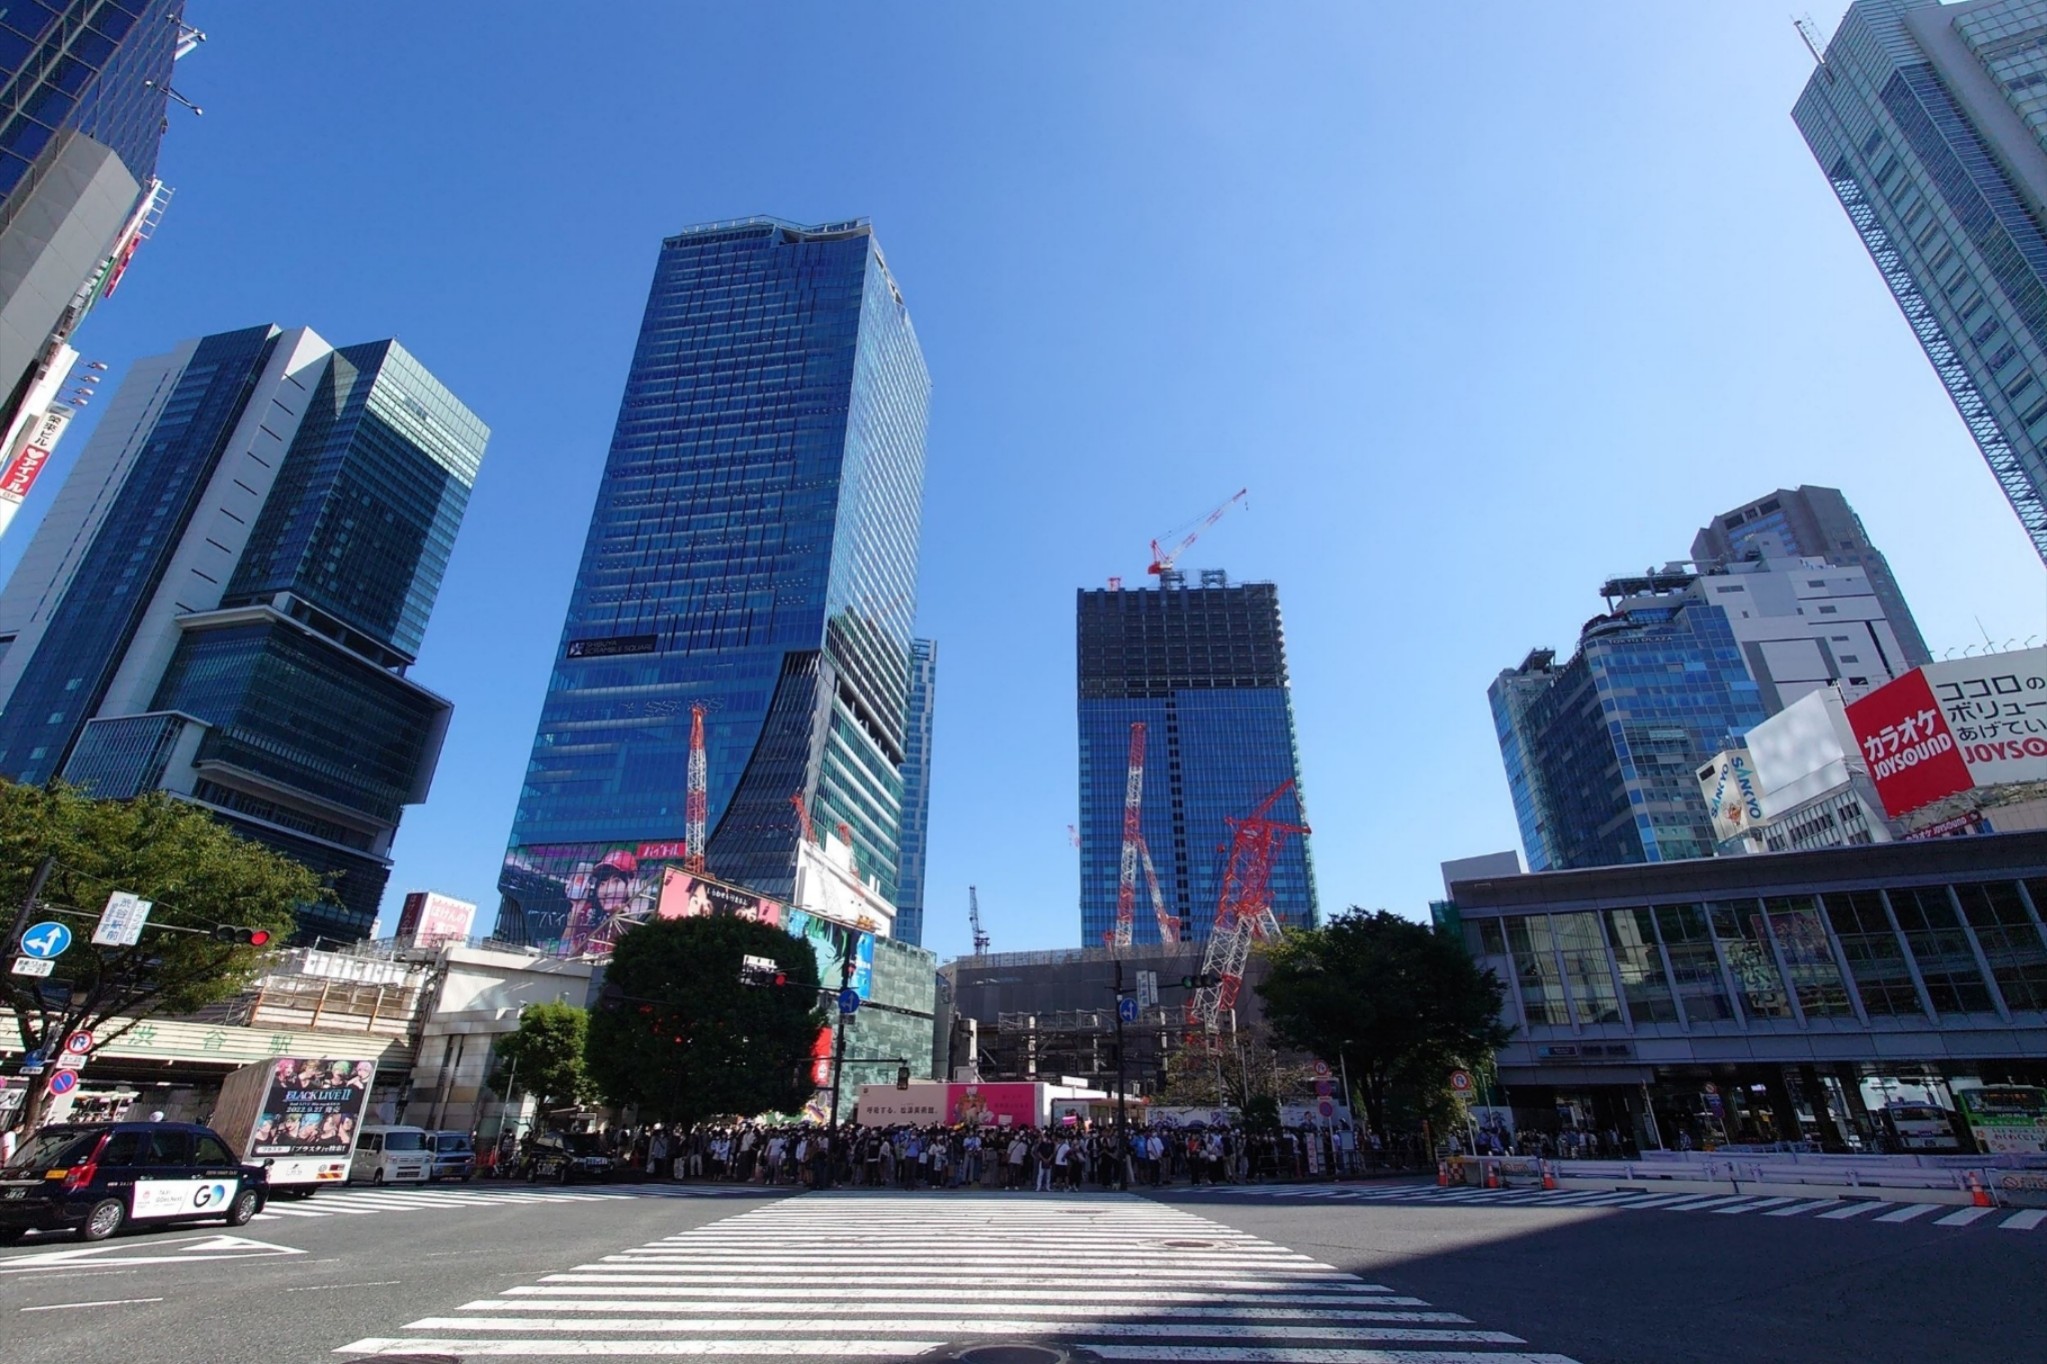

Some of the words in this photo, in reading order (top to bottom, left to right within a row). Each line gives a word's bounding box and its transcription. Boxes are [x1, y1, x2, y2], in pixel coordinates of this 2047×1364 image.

[6, 456, 39, 493] アイフル
[1935, 675, 2046, 702] ココロの
[1864, 708, 1937, 762] カラオケ
[1957, 718, 2047, 742] あげてい
[1873, 732, 1953, 781] JOYSOUND
[1711, 763, 1729, 819] SANKYO
[1731, 756, 1762, 819] SANKYO
[1933, 816, 1967, 835] JOYSOUND
[285, 1090, 317, 1101] BLACK
[318, 1089, 342, 1100] LIVE
[193, 1184, 226, 1208] GO
